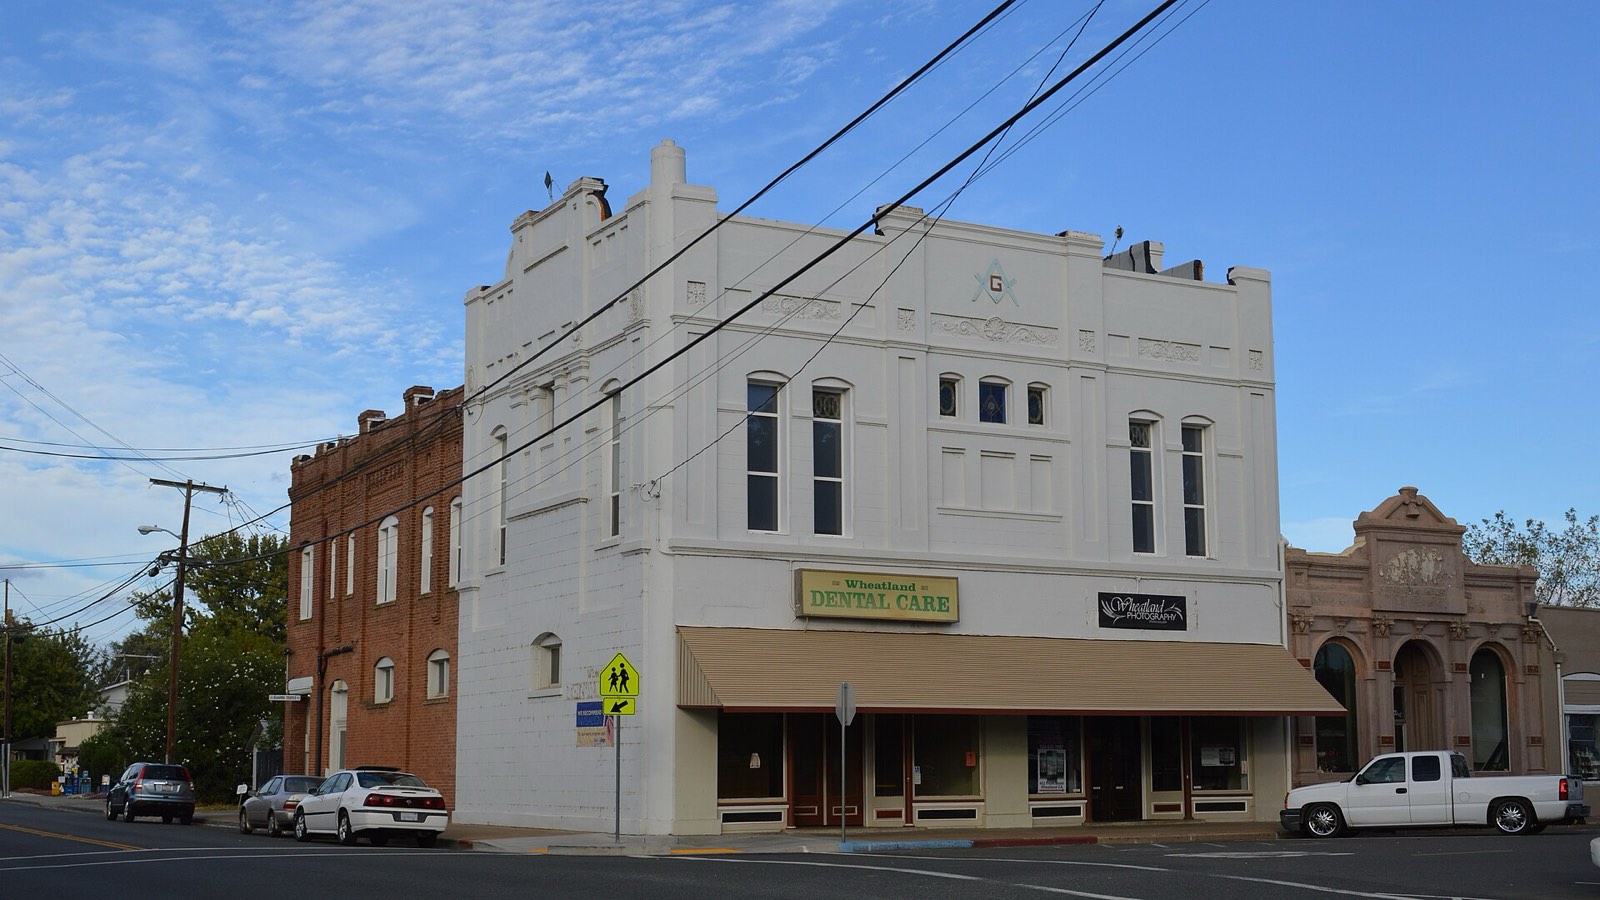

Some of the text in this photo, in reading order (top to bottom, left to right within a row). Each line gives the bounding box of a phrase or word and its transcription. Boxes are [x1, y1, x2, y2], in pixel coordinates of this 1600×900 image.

[990, 275, 1002, 292] G
[845, 579, 916, 591] Wheatland
[810, 590, 950, 612] DENTAL CARE
[1127, 612, 1176, 621] PHOTOGRAPHY
